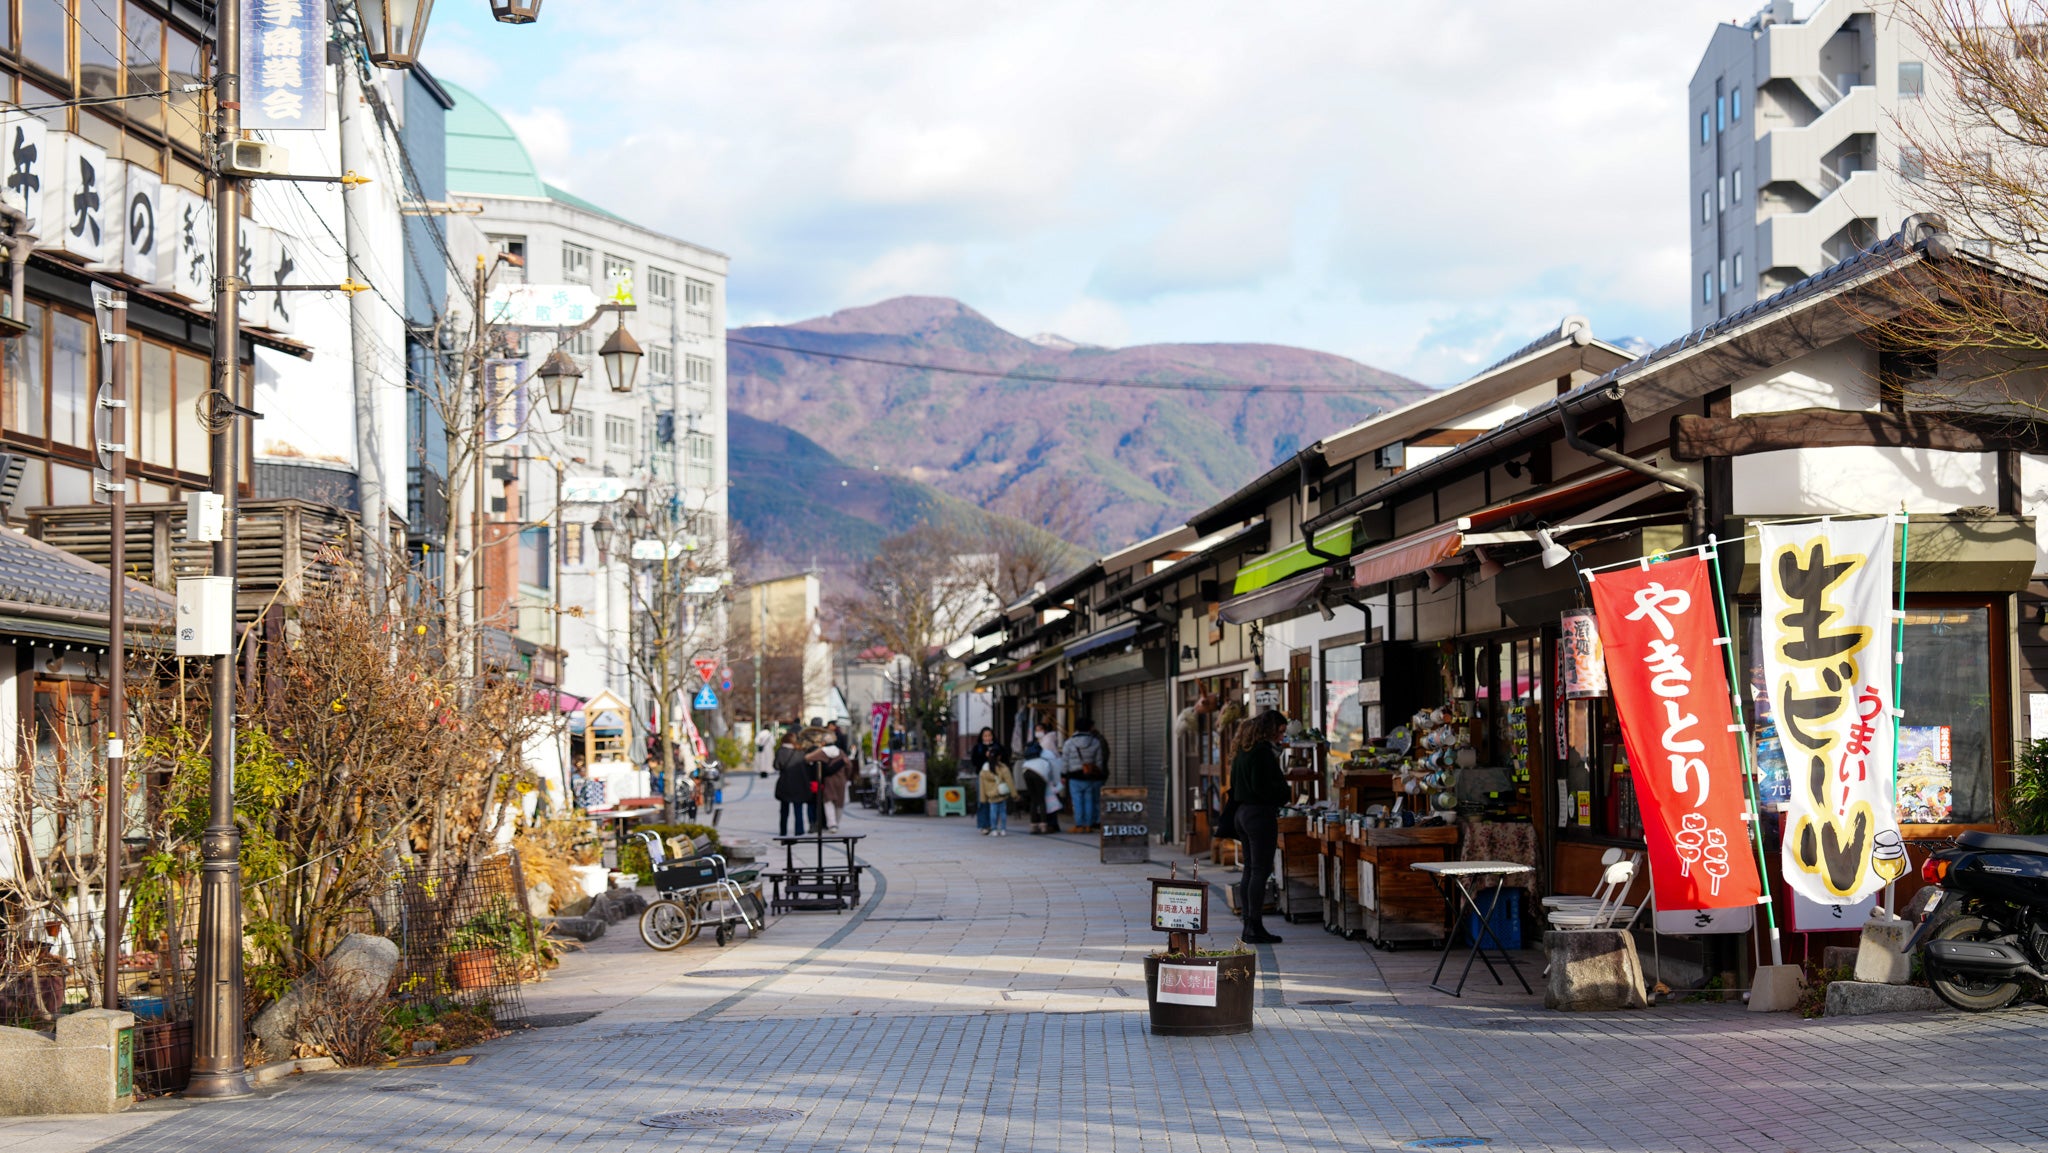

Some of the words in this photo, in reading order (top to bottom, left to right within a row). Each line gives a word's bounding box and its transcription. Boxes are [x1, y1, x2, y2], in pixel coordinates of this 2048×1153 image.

[1625, 581, 1710, 808] やきとり
[1776, 540, 1870, 893] 生ビール
[1106, 801, 1143, 812] PINO
[1103, 824, 1148, 836] LIBRO
[1157, 904, 1200, 915] 車両進入禁止
[1161, 974, 1215, 989] 進入禁止
